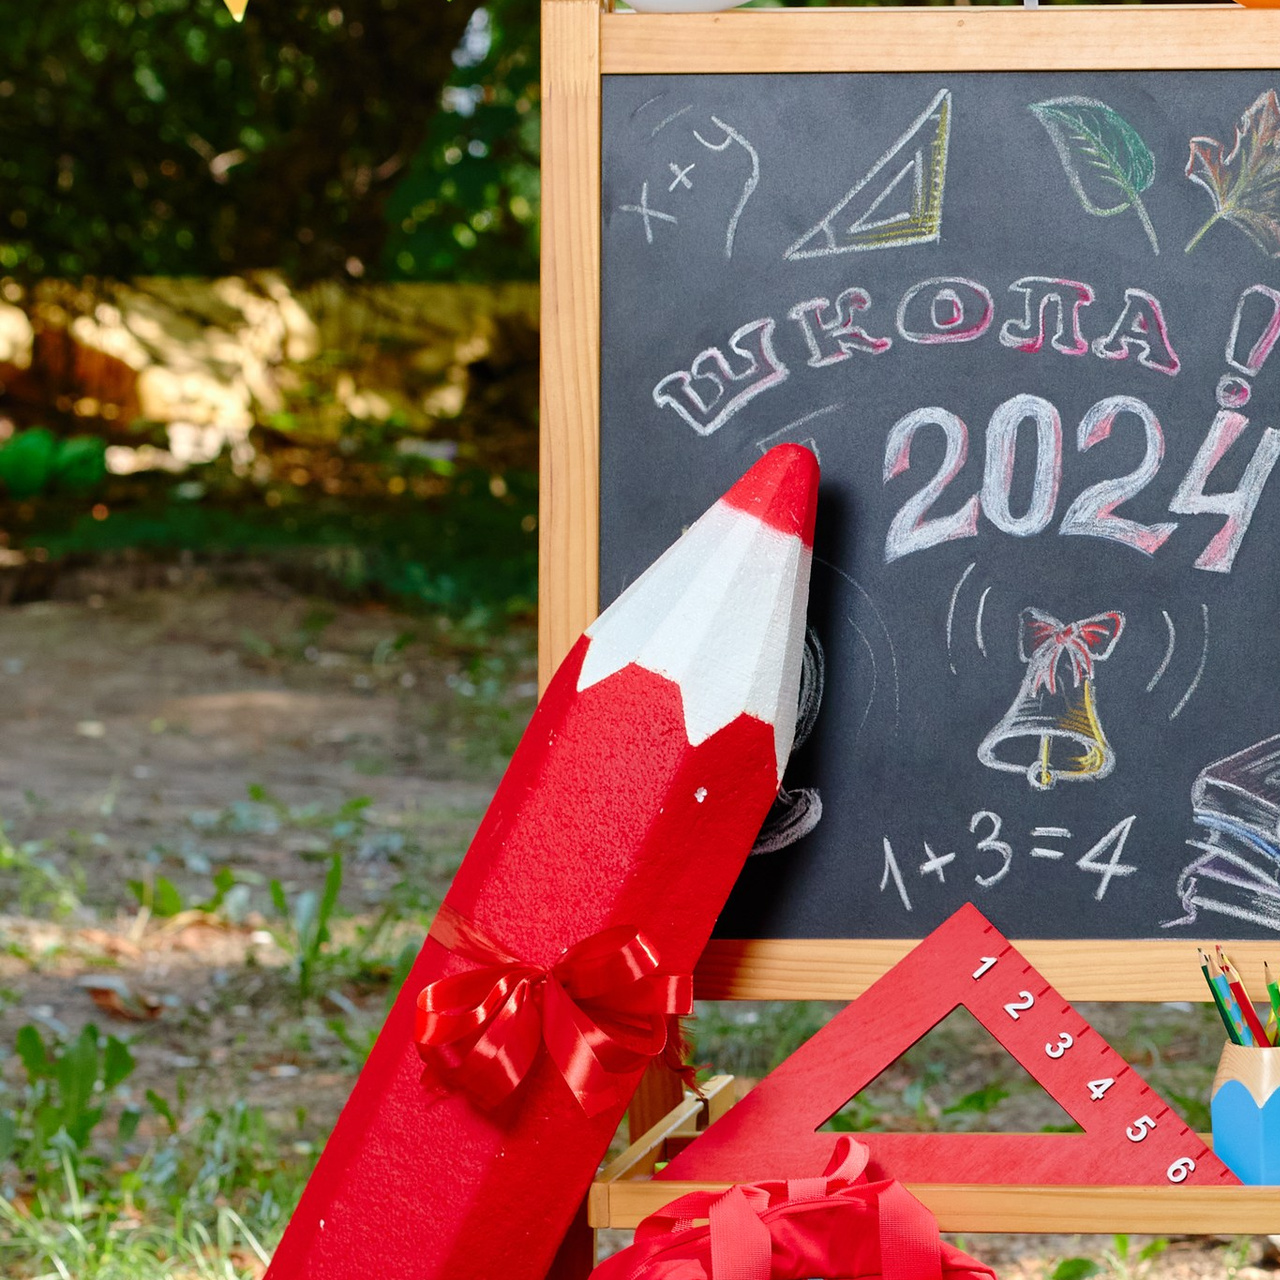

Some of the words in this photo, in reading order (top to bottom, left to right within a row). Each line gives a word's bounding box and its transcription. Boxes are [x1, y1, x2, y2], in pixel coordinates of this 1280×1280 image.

[972, 956, 998, 980] 1
[1003, 990, 1036, 1021] 2
[1045, 1032, 1074, 1059] 3
[1086, 1077, 1116, 1102] 4
[1126, 1114, 1157, 1143] 5
[1166, 1156, 1196, 1184] 6
